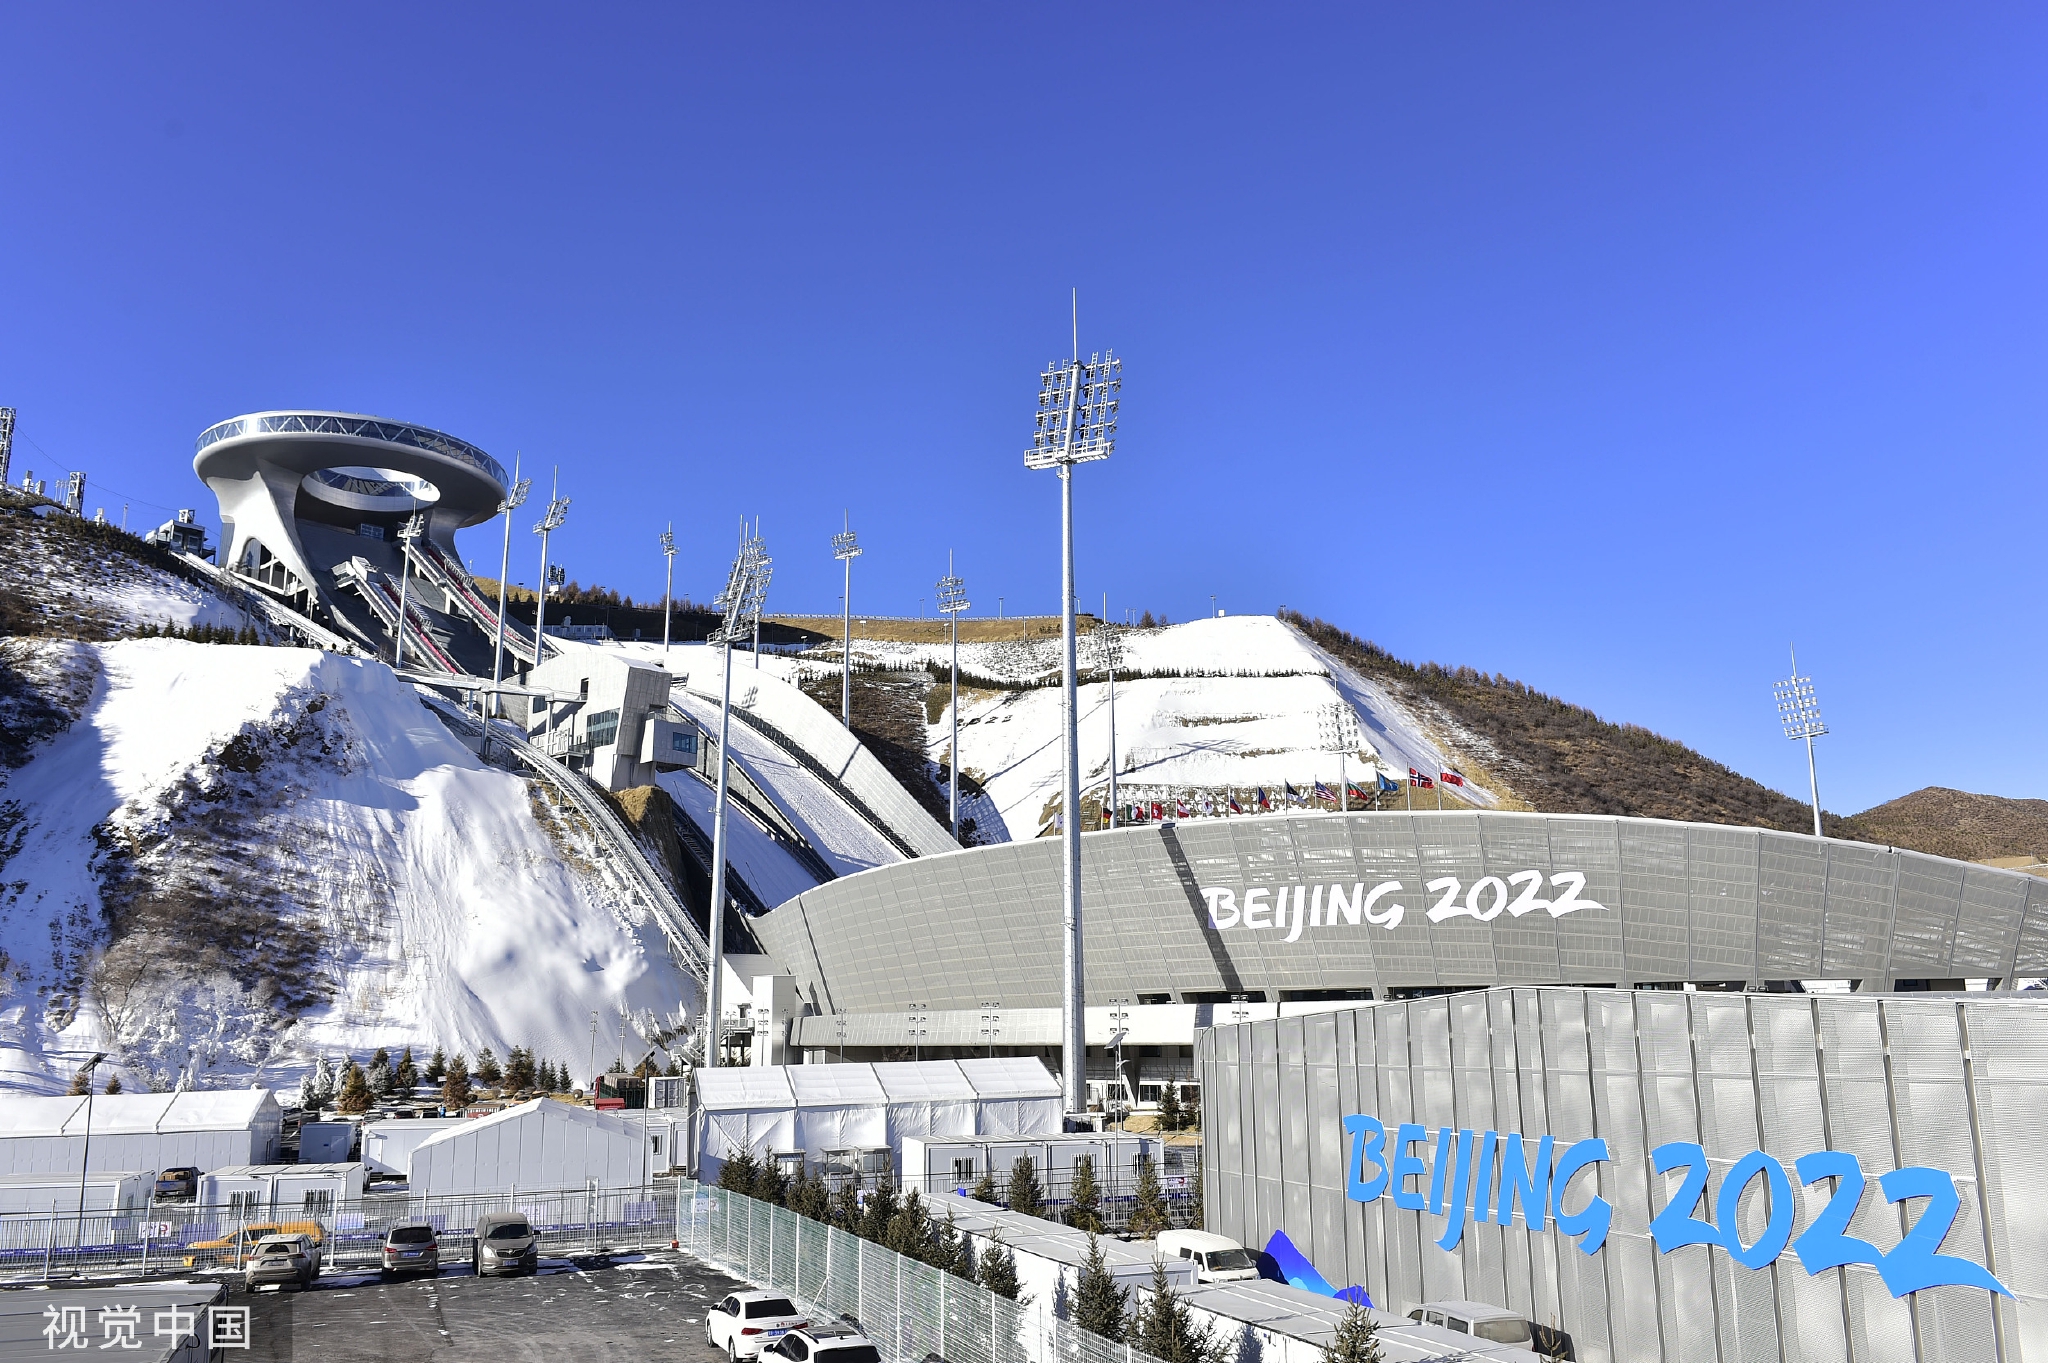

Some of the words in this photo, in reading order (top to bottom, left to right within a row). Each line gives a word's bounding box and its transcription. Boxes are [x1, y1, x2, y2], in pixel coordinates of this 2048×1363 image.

[1200, 880, 1405, 943] BEIJING
[1425, 869, 1609, 924] 2022
[1344, 1113, 1613, 1256] BEIJING
[1649, 1141, 2018, 1300] 2022
